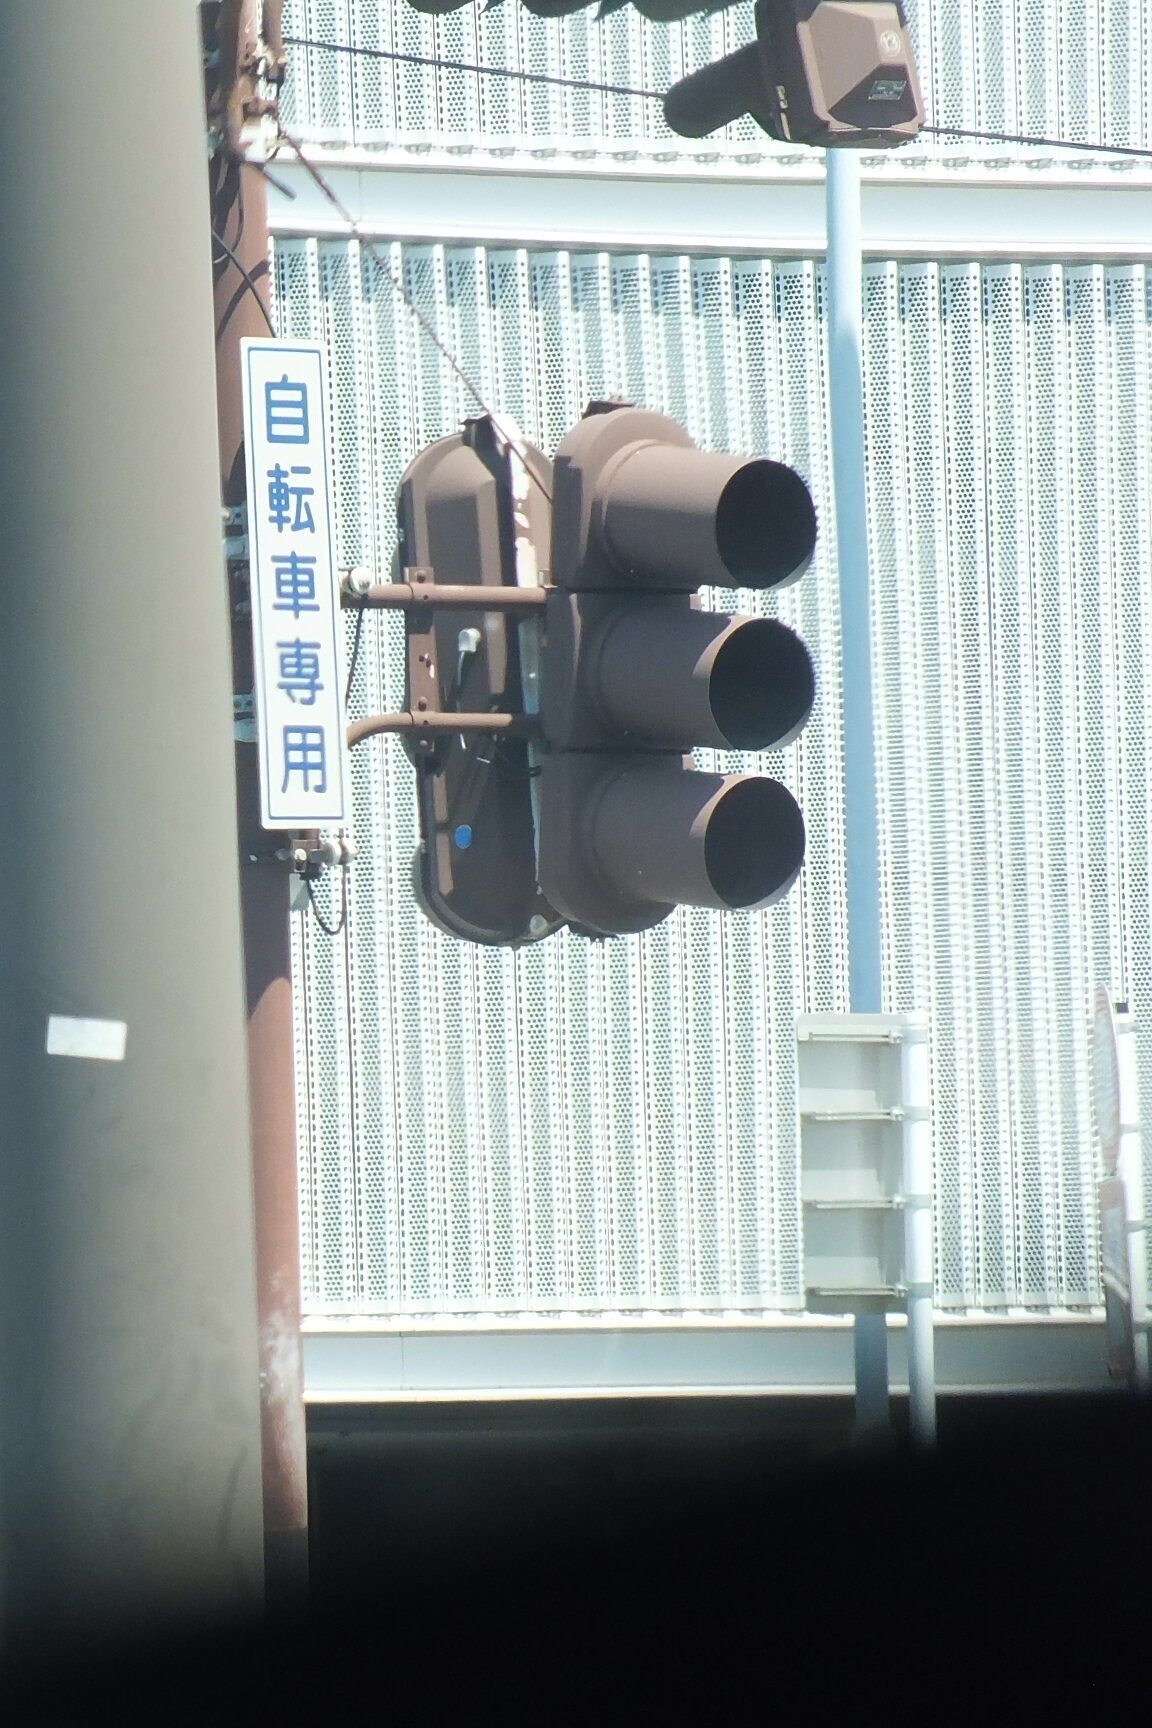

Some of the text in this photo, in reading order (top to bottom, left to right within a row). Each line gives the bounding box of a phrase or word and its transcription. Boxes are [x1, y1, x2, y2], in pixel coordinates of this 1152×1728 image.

[264, 373, 326, 794] 自転車専用
